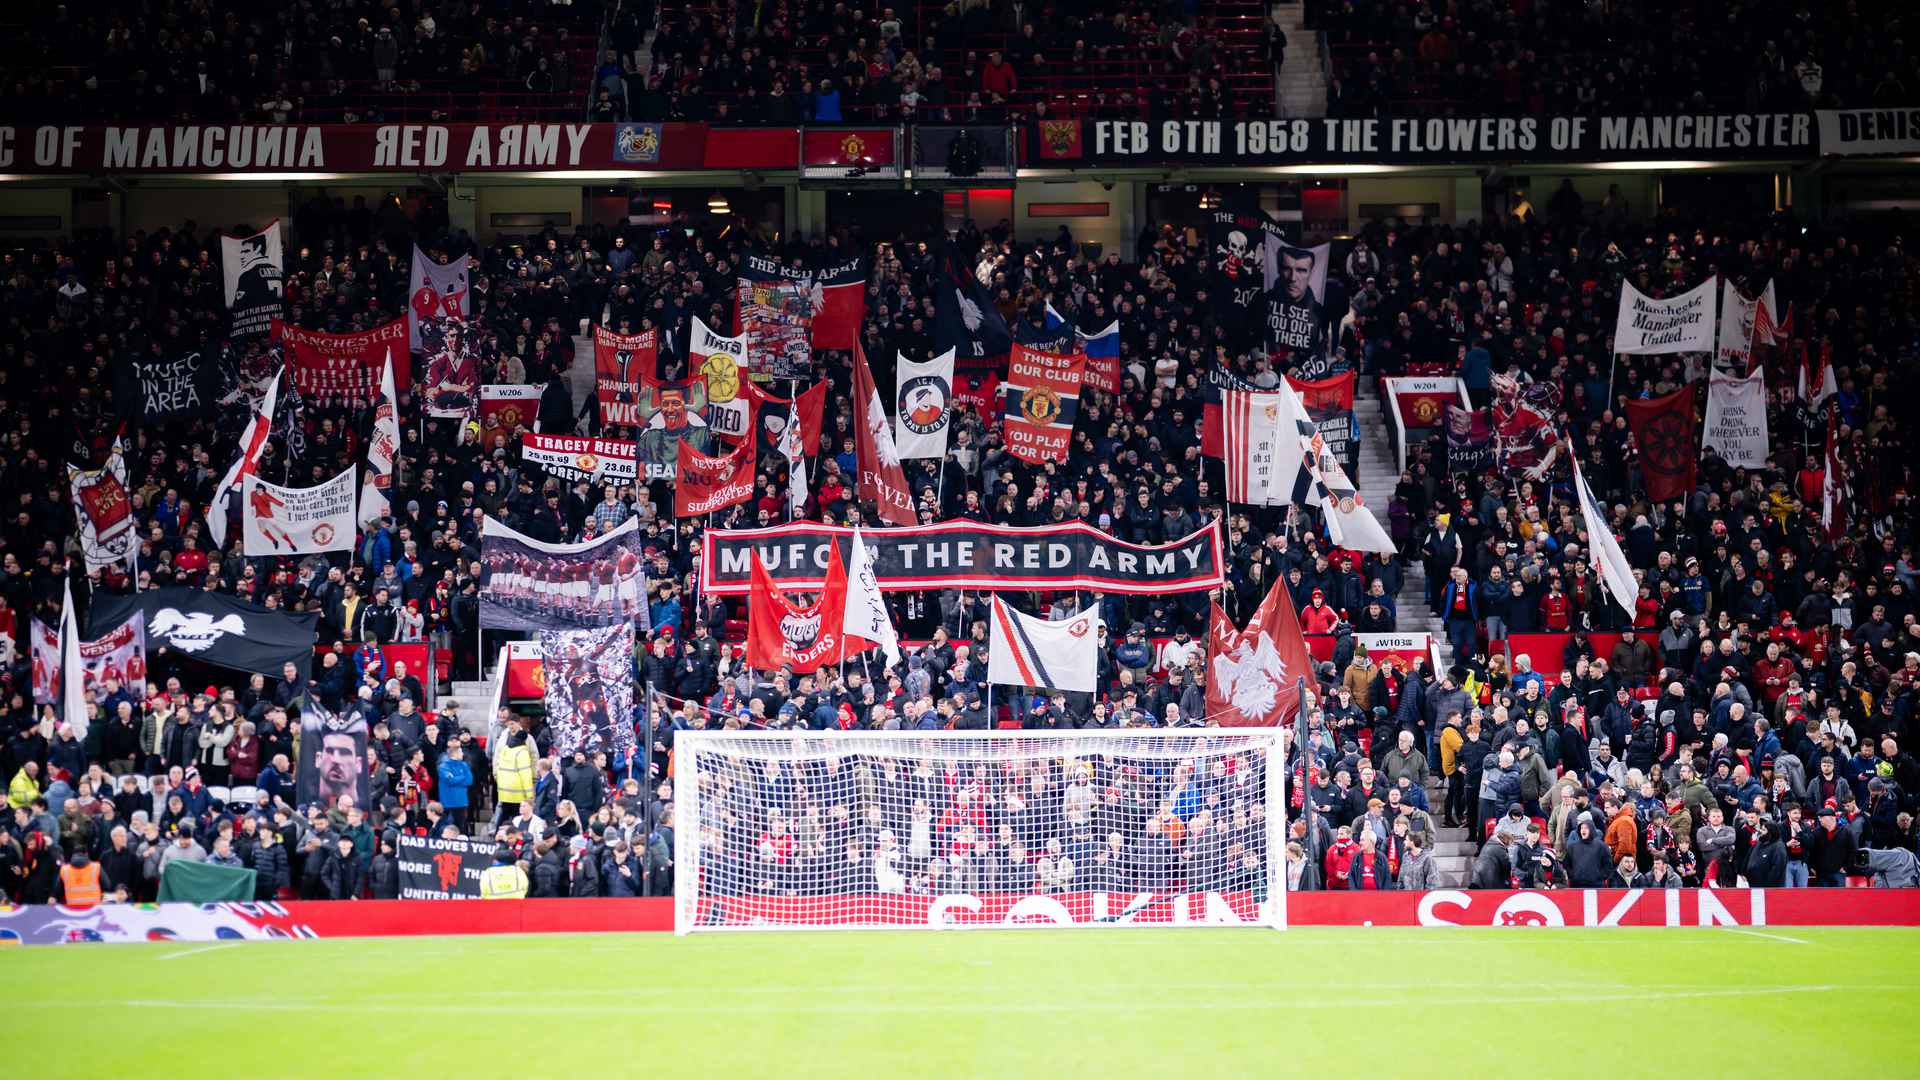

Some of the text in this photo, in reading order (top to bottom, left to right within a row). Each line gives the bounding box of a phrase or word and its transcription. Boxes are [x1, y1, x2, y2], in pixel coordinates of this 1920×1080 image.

[1096, 114, 1810, 155] FEB 6TH 1958 THE FLOWERS OF MANCHESTER
[1839, 111, 1920, 142] DENIS
[34, 125, 83, 167] OF
[1214, 212, 1235, 224] THE
[1261, 222, 1286, 237] ARM
[749, 256, 776, 273] THE
[423, 293, 430, 305] 9
[1269, 301, 1309, 320] 'LL SEE
[1290, 319, 1313, 335] OUT
[281, 323, 405, 352] MANCHESTER
[618, 340, 653, 350] ENGLAND
[625, 331, 655, 344] MORE
[1274, 331, 1311, 349] THERE
[972, 341, 985, 357] IS
[1023, 352, 1071, 368] THIS IS
[1013, 363, 1041, 377] OUR
[1045, 367, 1080, 383] CLUB
[142, 373, 193, 395] IN THE
[1413, 382, 1437, 390] W204
[144, 386, 201, 415] AREA
[906, 420, 919, 432] PAY
[535, 436, 637, 457] TRACEY REEVE
[1036, 434, 1068, 449] PLAY
[528, 451, 569, 464] 25.05.69
[1011, 445, 1057, 461] FOR US
[1738, 450, 1753, 460] BE
[541, 463, 598, 483] FOREVE
[645, 463, 678, 480] SEA
[340, 493, 353, 503] rest
[294, 512, 309, 521] just
[898, 543, 973, 570] THE
[994, 542, 1072, 568] RED
[1089, 542, 1203, 575] ARMY
[783, 634, 834, 664] ENDERS
[401, 836, 497, 856] DAD LOVES YOU
[398, 861, 432, 874] MORE
[403, 888, 449, 900] UNITED
